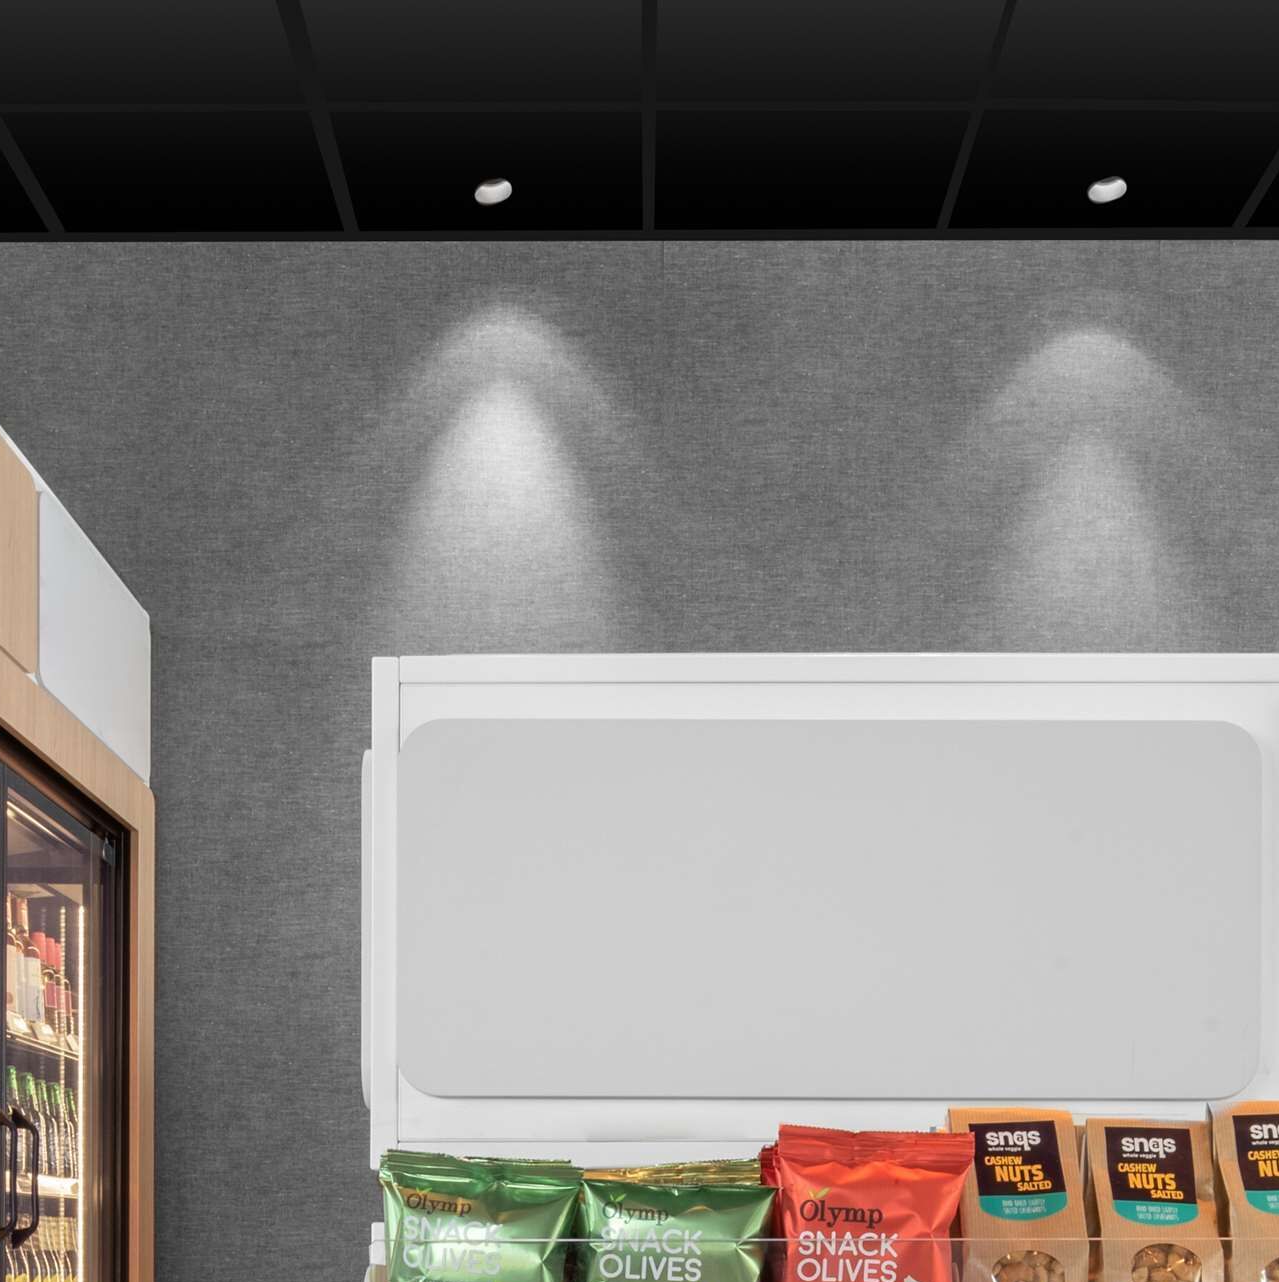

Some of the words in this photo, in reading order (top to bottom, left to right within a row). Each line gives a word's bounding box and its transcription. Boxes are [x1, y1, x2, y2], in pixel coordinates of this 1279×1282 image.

[985, 1156, 1023, 1167] CASHEW
[1117, 1162, 1157, 1173] CASHEW
[994, 1165, 1044, 1182] NUTS
[1128, 1172, 1177, 1190] NUTS
[1017, 1180, 1052, 1192] SALTED
[406, 1193, 472, 1216] Olymp
[602, 1202, 669, 1225] Olymp
[799, 1199, 883, 1228] Olymp
[403, 1216, 504, 1248] SNACK
[600, 1228, 703, 1255] SNACK
[798, 1231, 898, 1258] SNACK
[402, 1244, 502, 1276] OLIVES
[599, 1254, 702, 1282] OLIVES
